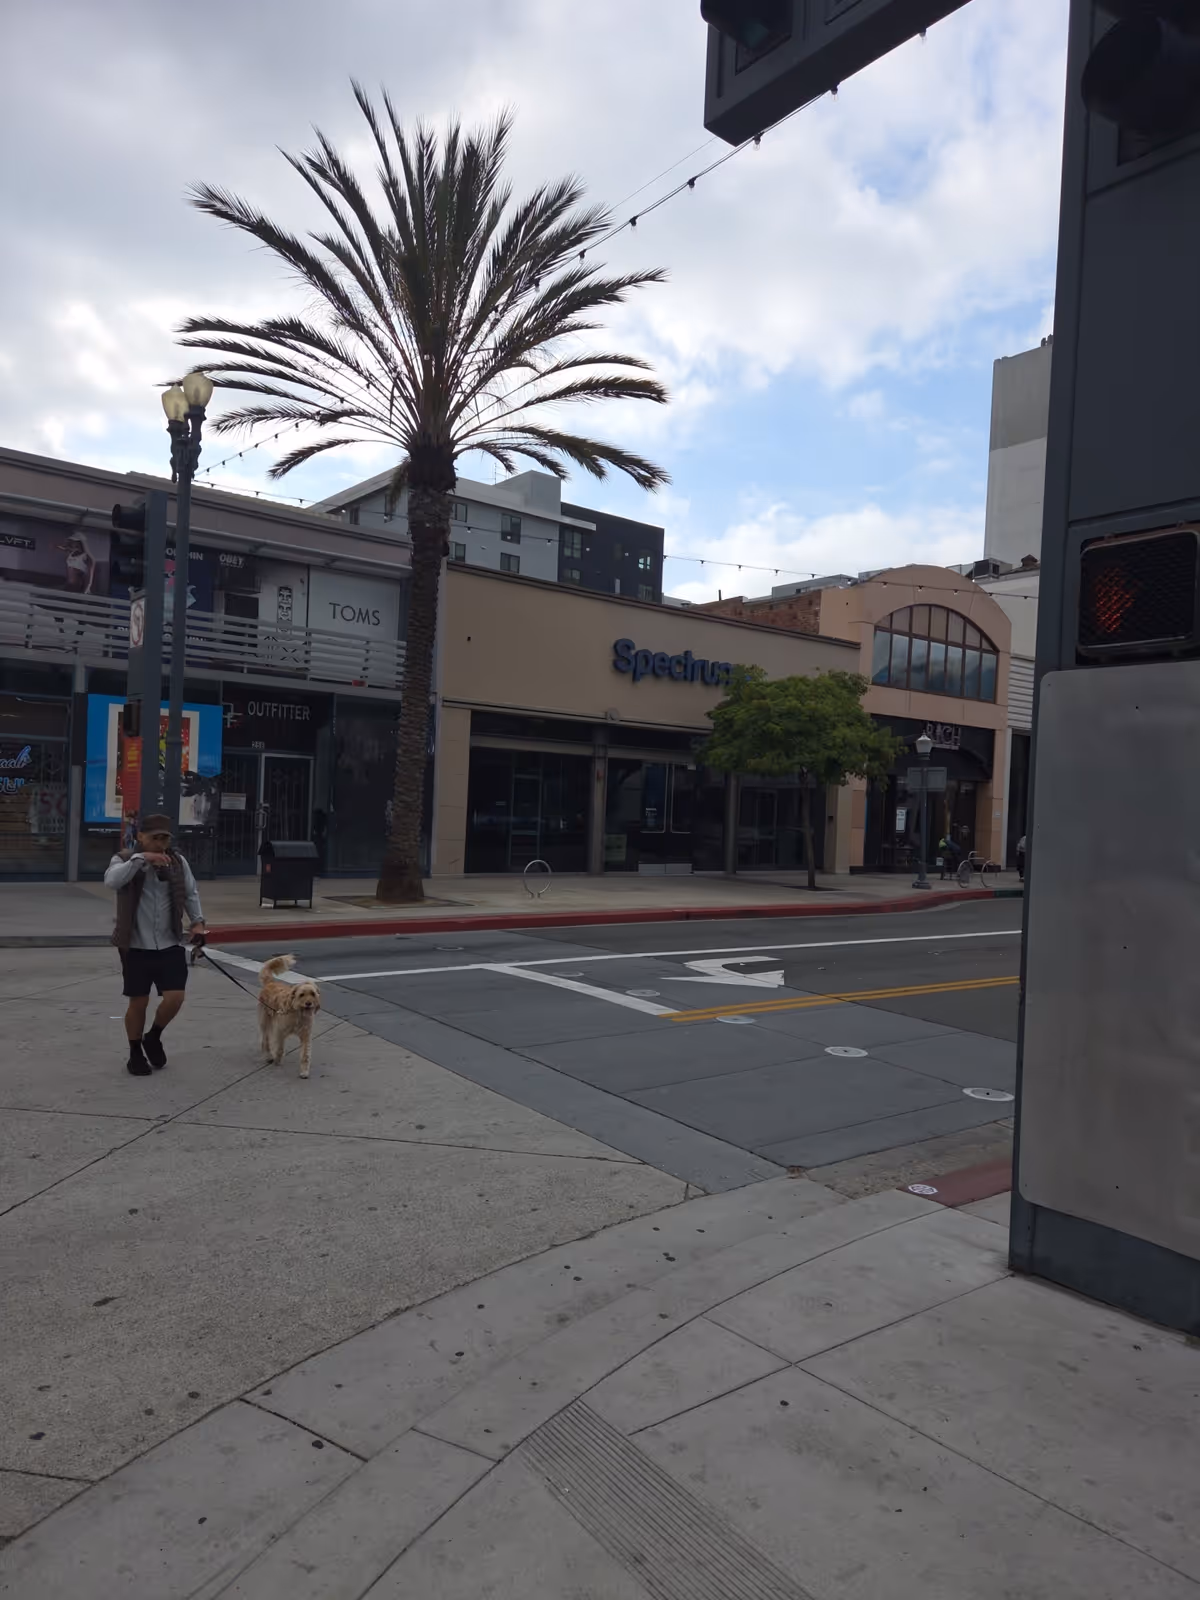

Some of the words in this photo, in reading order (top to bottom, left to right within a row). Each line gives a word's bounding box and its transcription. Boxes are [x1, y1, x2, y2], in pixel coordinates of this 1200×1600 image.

[219, 553, 245, 566] OBEY
[328, 602, 381, 626] TOMS
[247, 700, 311, 721] OUTFITTER
